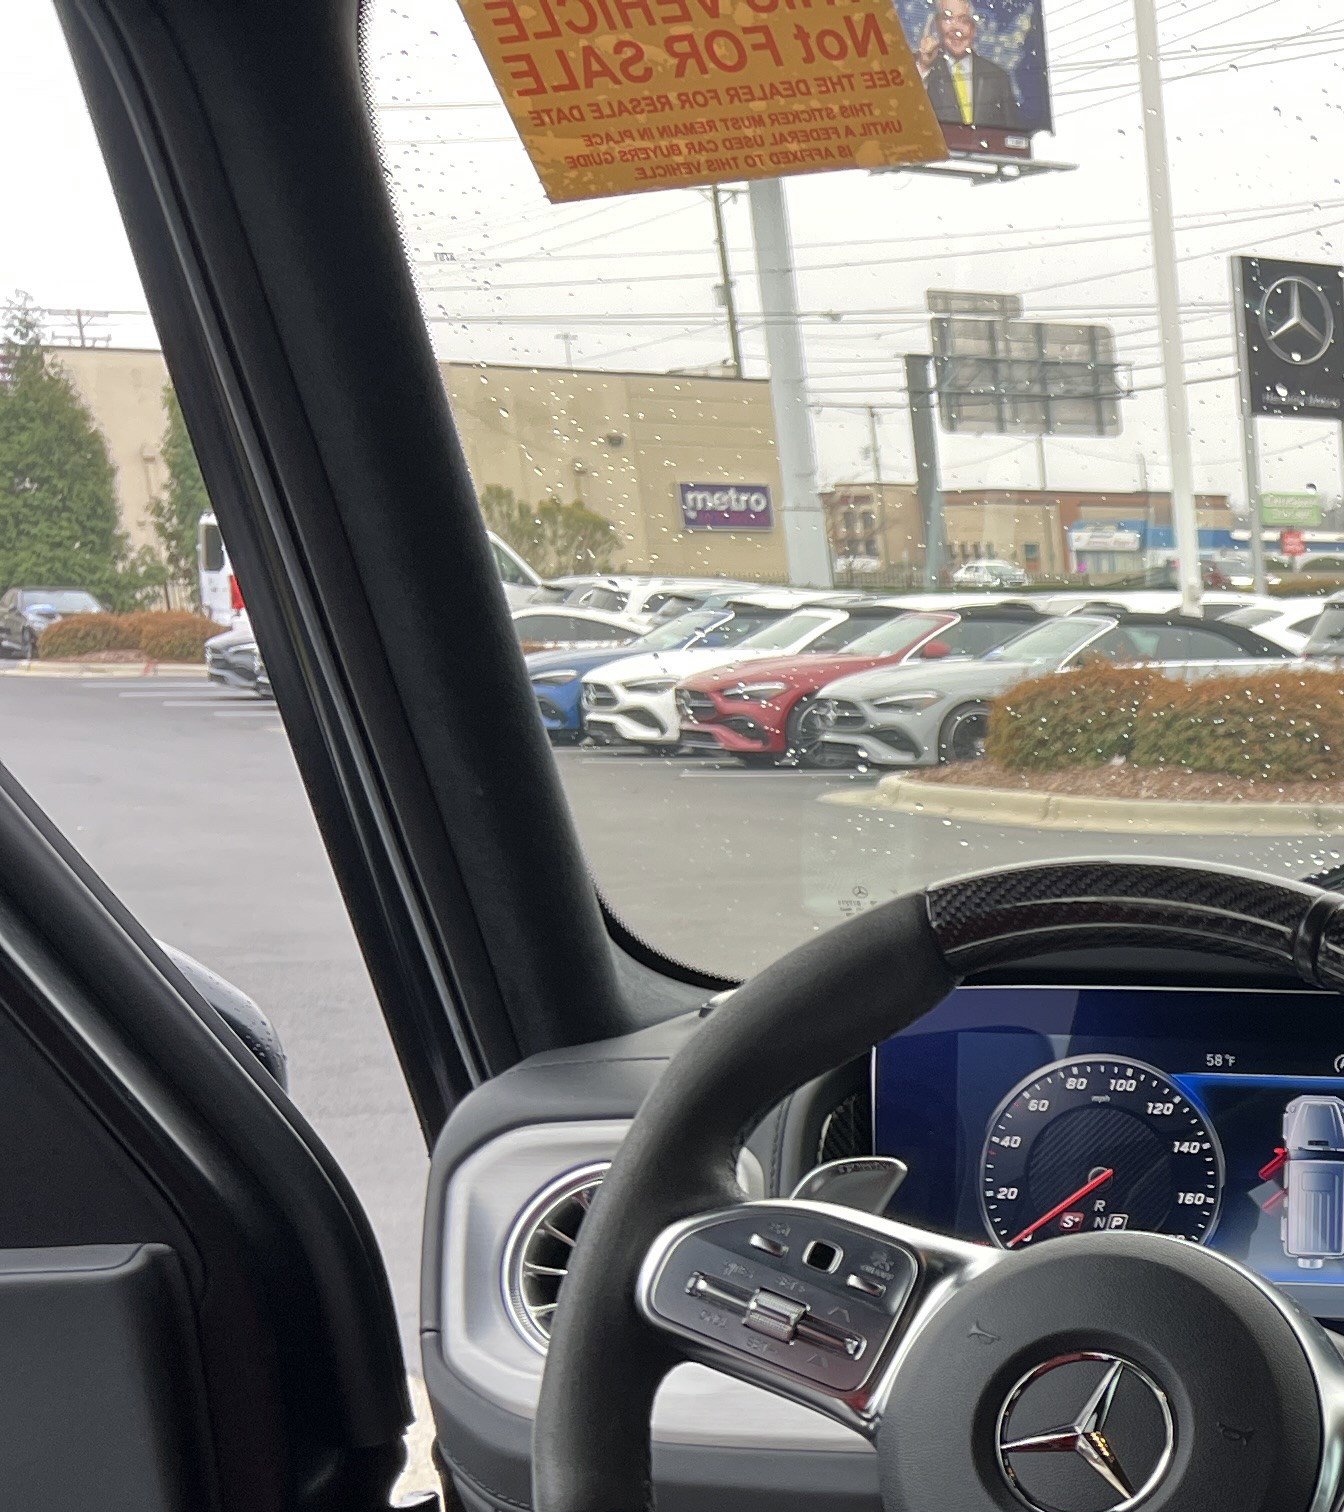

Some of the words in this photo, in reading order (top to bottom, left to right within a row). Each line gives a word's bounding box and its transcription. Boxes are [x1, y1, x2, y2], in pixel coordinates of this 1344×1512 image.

[685, 487, 767, 512] metro
[1206, 1054, 1222, 1067] 58
[1065, 1078, 1088, 1090] 80
[1109, 1079, 1137, 1092] 100
[1028, 1100, 1049, 1112] 60
[1147, 1102, 1174, 1115] 120
[1000, 1136, 1021, 1148] 40
[1173, 1141, 1200, 1154] 140
[996, 1187, 1018, 1200] 20
[1177, 1192, 1205, 1205] 160
[1094, 1200, 1105, 1212] R
[1094, 1217, 1106, 1229] N
[1111, 1218, 1124, 1228] P
